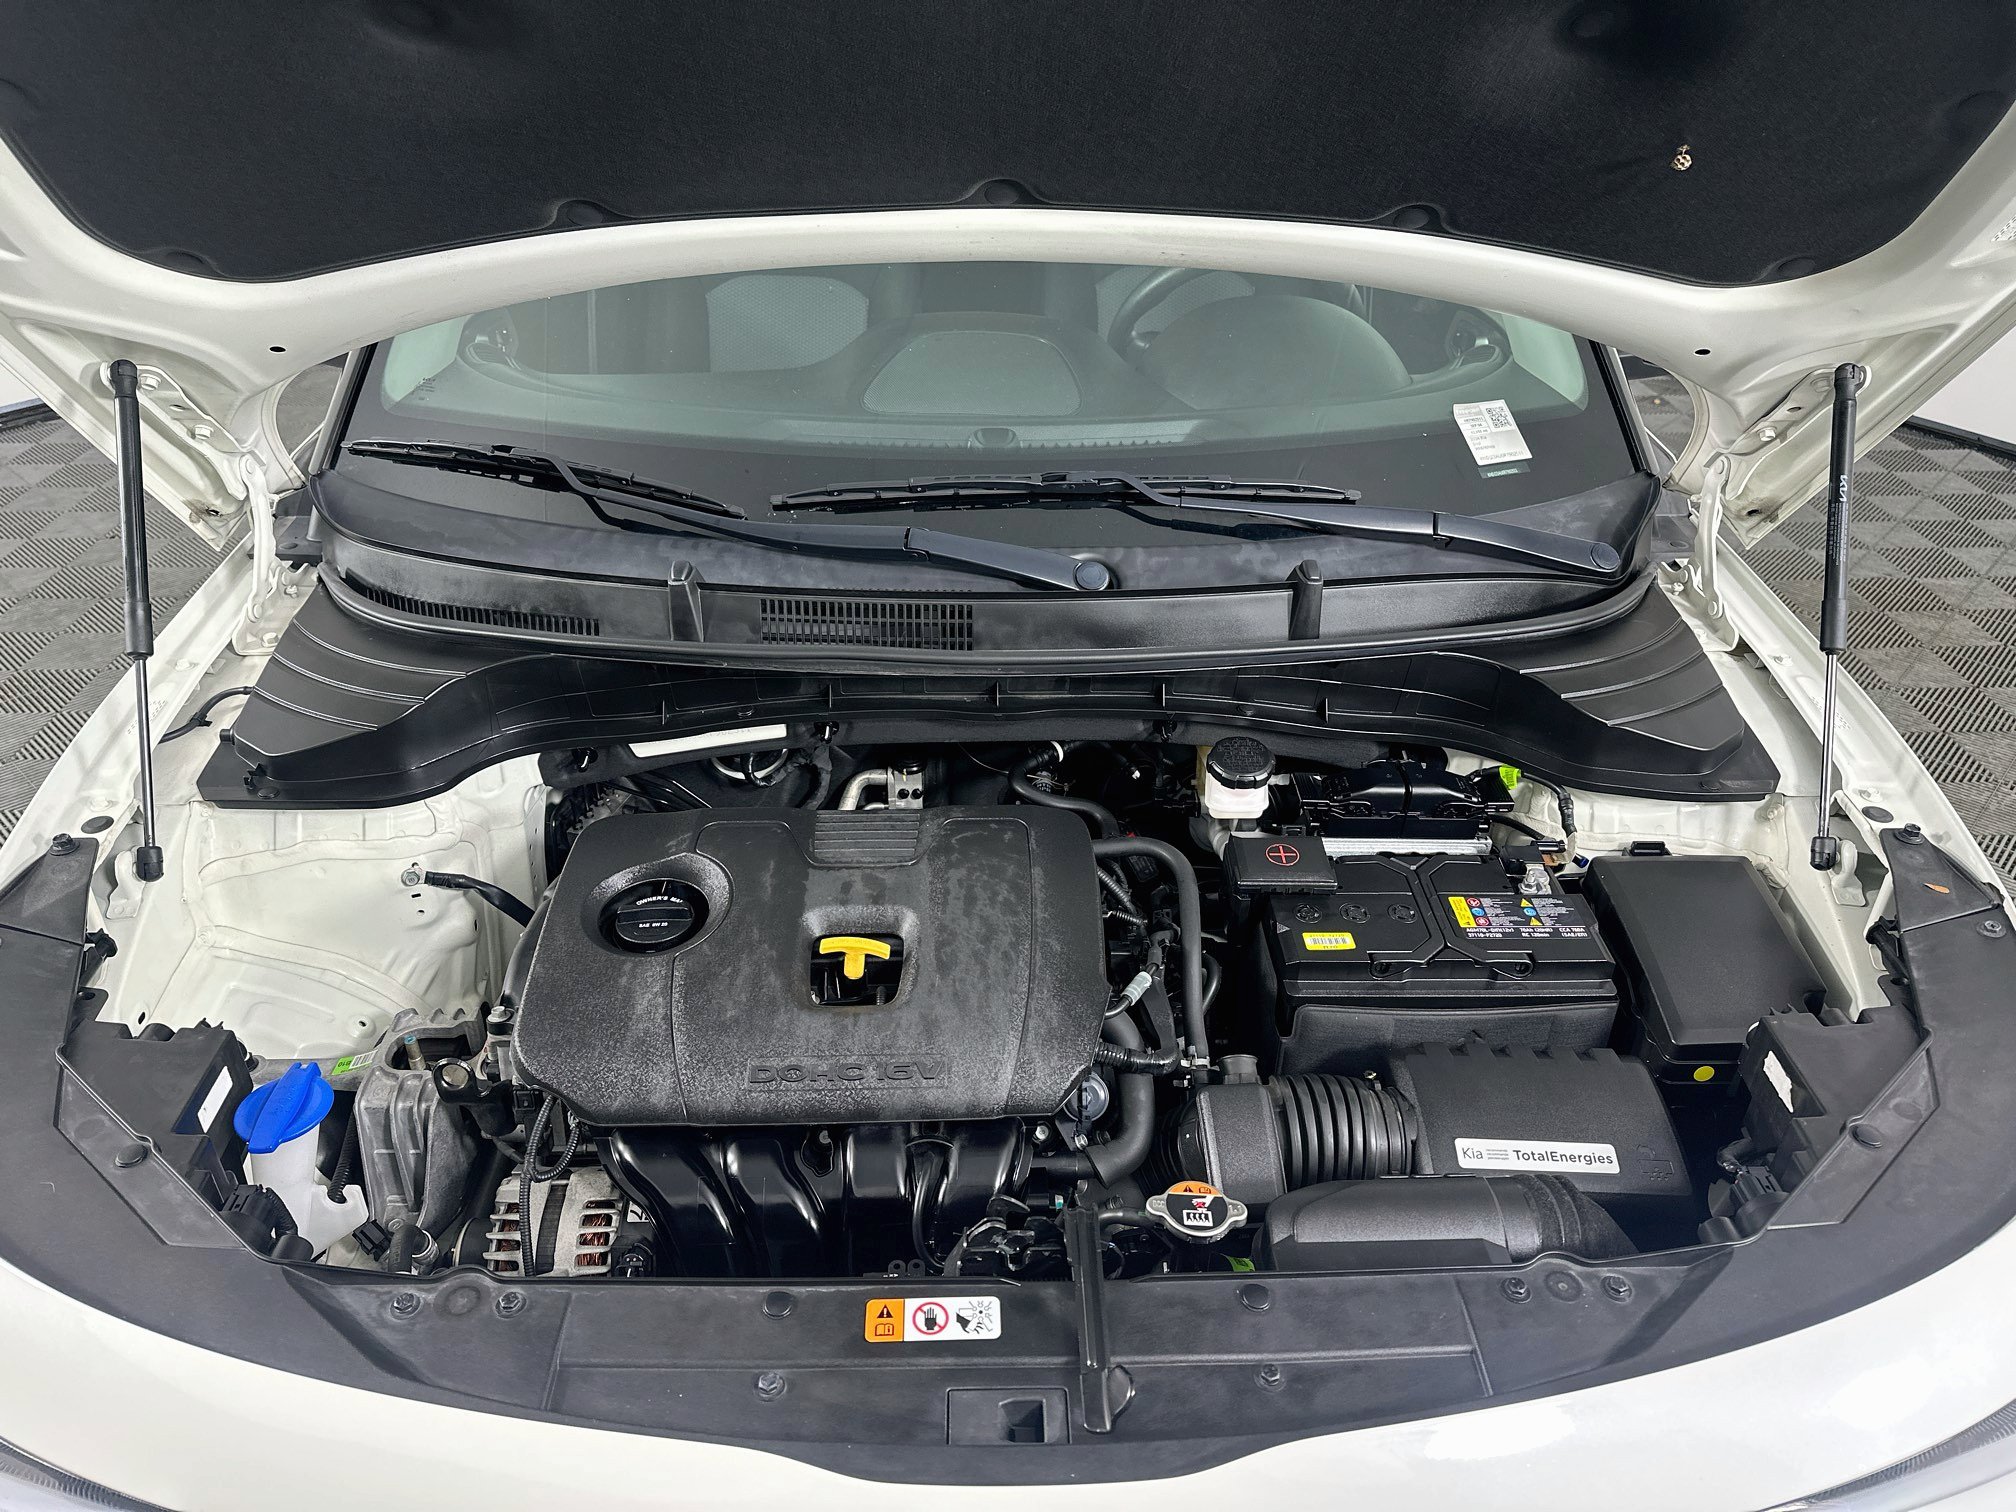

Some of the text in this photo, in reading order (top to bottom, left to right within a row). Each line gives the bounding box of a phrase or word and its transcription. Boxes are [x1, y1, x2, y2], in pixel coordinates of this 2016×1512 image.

[636, 895, 669, 906] OWNER'S
[749, 1061, 944, 1084] DOHC 16V
[1461, 1147, 1614, 1166] Kia TotalEnergies
